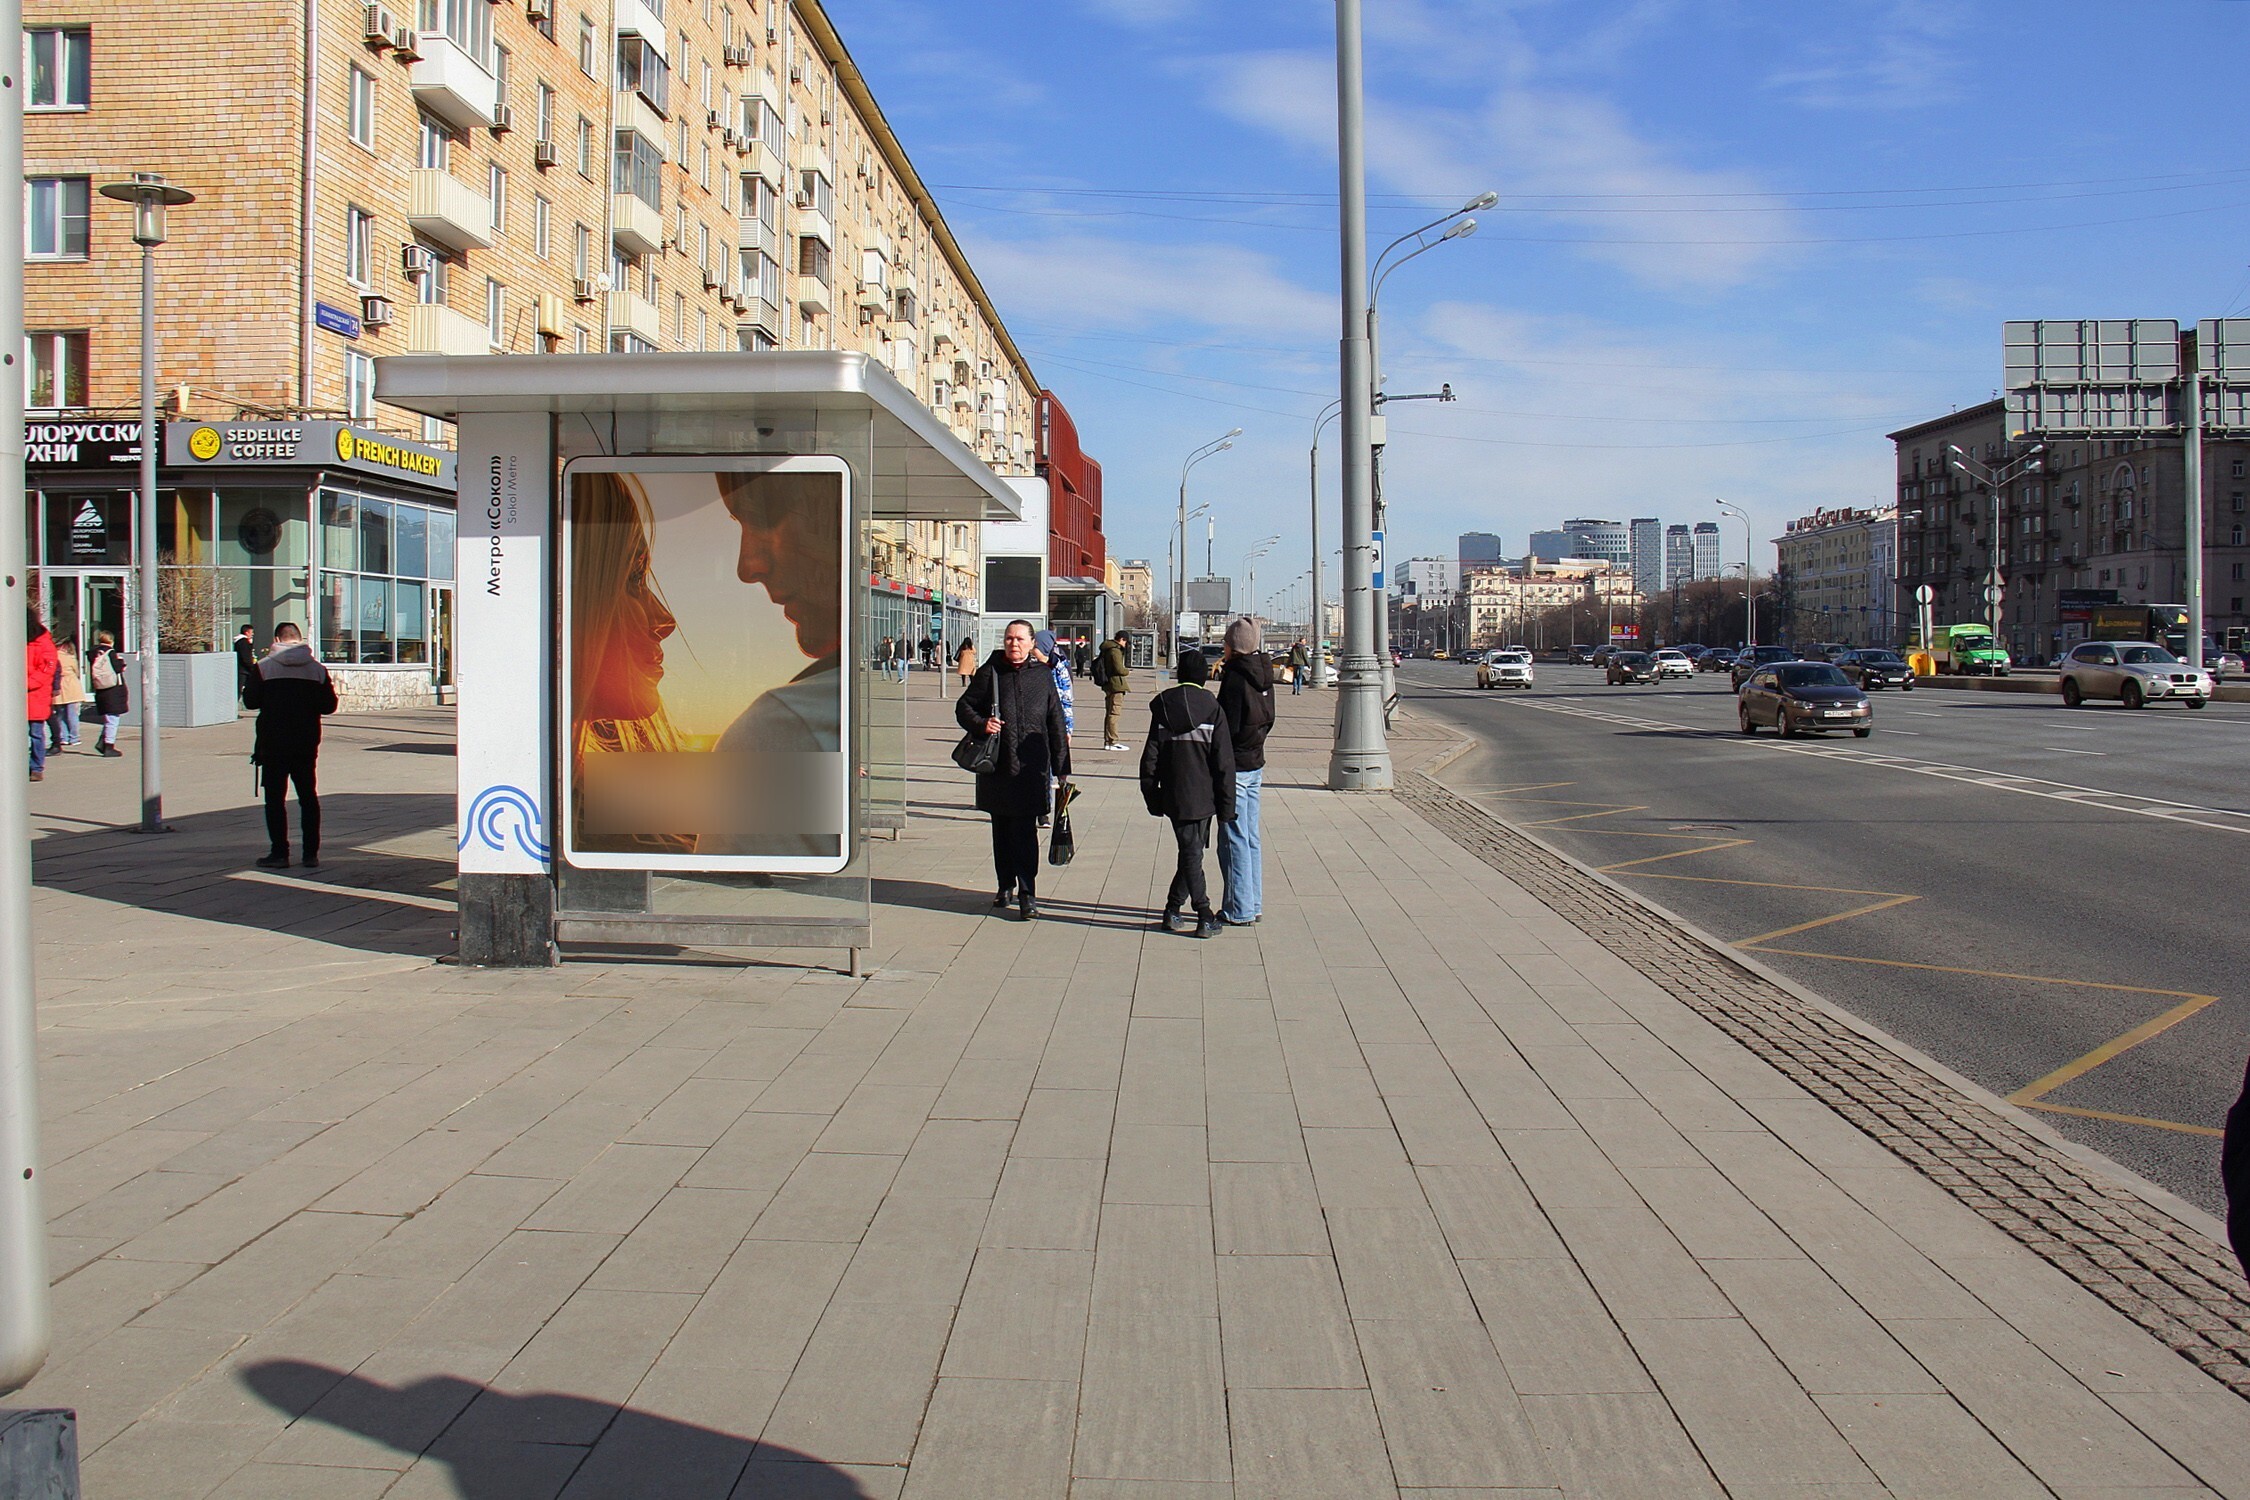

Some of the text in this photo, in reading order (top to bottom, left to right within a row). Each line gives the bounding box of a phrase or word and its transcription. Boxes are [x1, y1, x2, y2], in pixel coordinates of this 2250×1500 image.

[351, 319, 359, 332] 74
[25, 424, 159, 443] ЛОРУССКИ
[227, 428, 302, 442] SEDELICE
[232, 444, 296, 457] COFFEE
[355, 438, 400, 467] FRENCH
[401, 449, 442, 477] BAKERY
[507, 455, 517, 524] Sokol Metro
[487, 455, 504, 596] Метро «Сокол»
